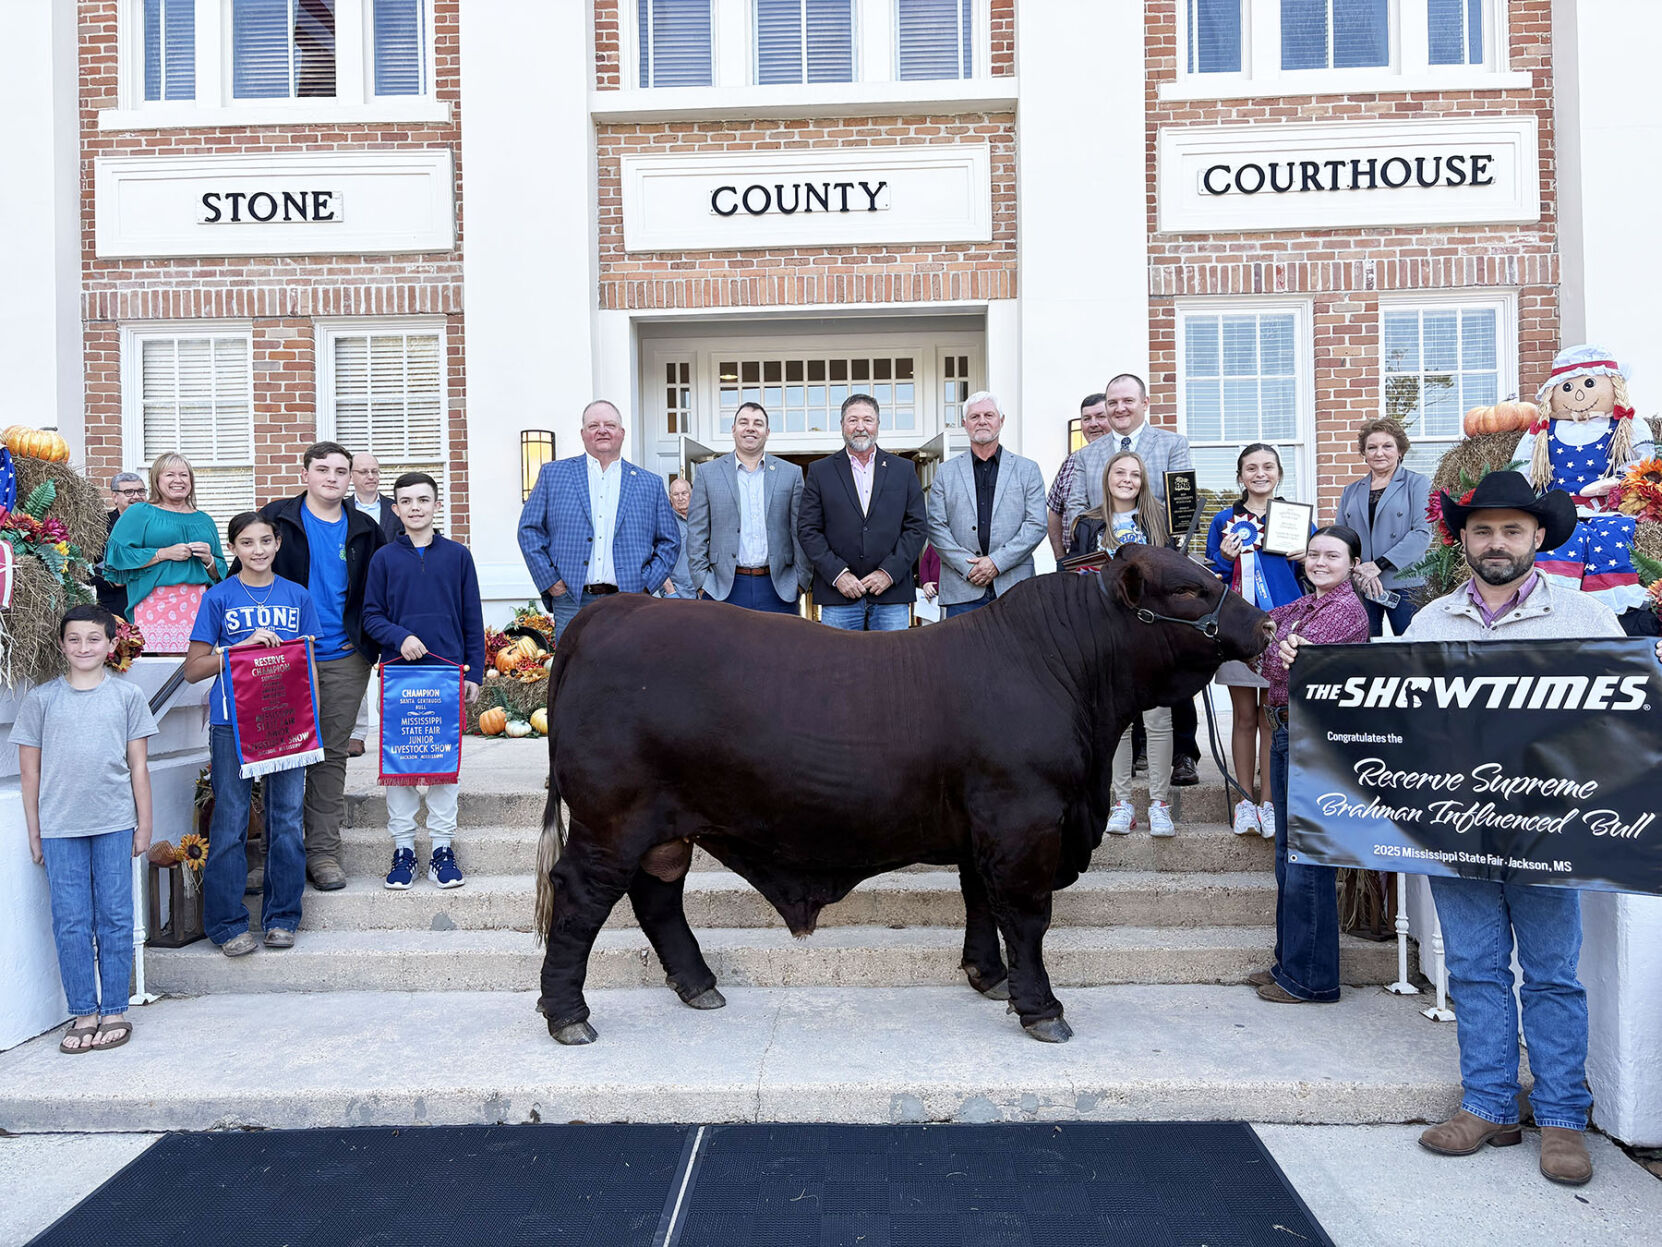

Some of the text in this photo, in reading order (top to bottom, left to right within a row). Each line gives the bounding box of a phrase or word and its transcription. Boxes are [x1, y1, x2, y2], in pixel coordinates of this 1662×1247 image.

[1203, 155, 1493, 195] COURTHOUSE
[711, 181, 887, 216] COUNTY
[202, 191, 334, 222] STONE
[225, 607, 297, 630] STONE
[254, 655, 285, 667] RESERVE
[251, 663, 290, 677] CHAMPION
[402, 688, 440, 698] CHAMPION
[1305, 684, 1343, 700] THE
[401, 716, 442, 725] MISSISSIPPI
[401, 726, 440, 735] STATE FAIR
[1327, 731, 1403, 744] Congratulates the
[409, 735, 434, 744] JUNIOR
[391, 743, 452, 754] LIVESTOCK SHOW
[1353, 757, 1599, 800] Reserve Supreme
[1316, 792, 1656, 839] Brahman Influenced Bull
[1373, 844, 1572, 872] 2025 Mississippi State Fair Jackson, MS
